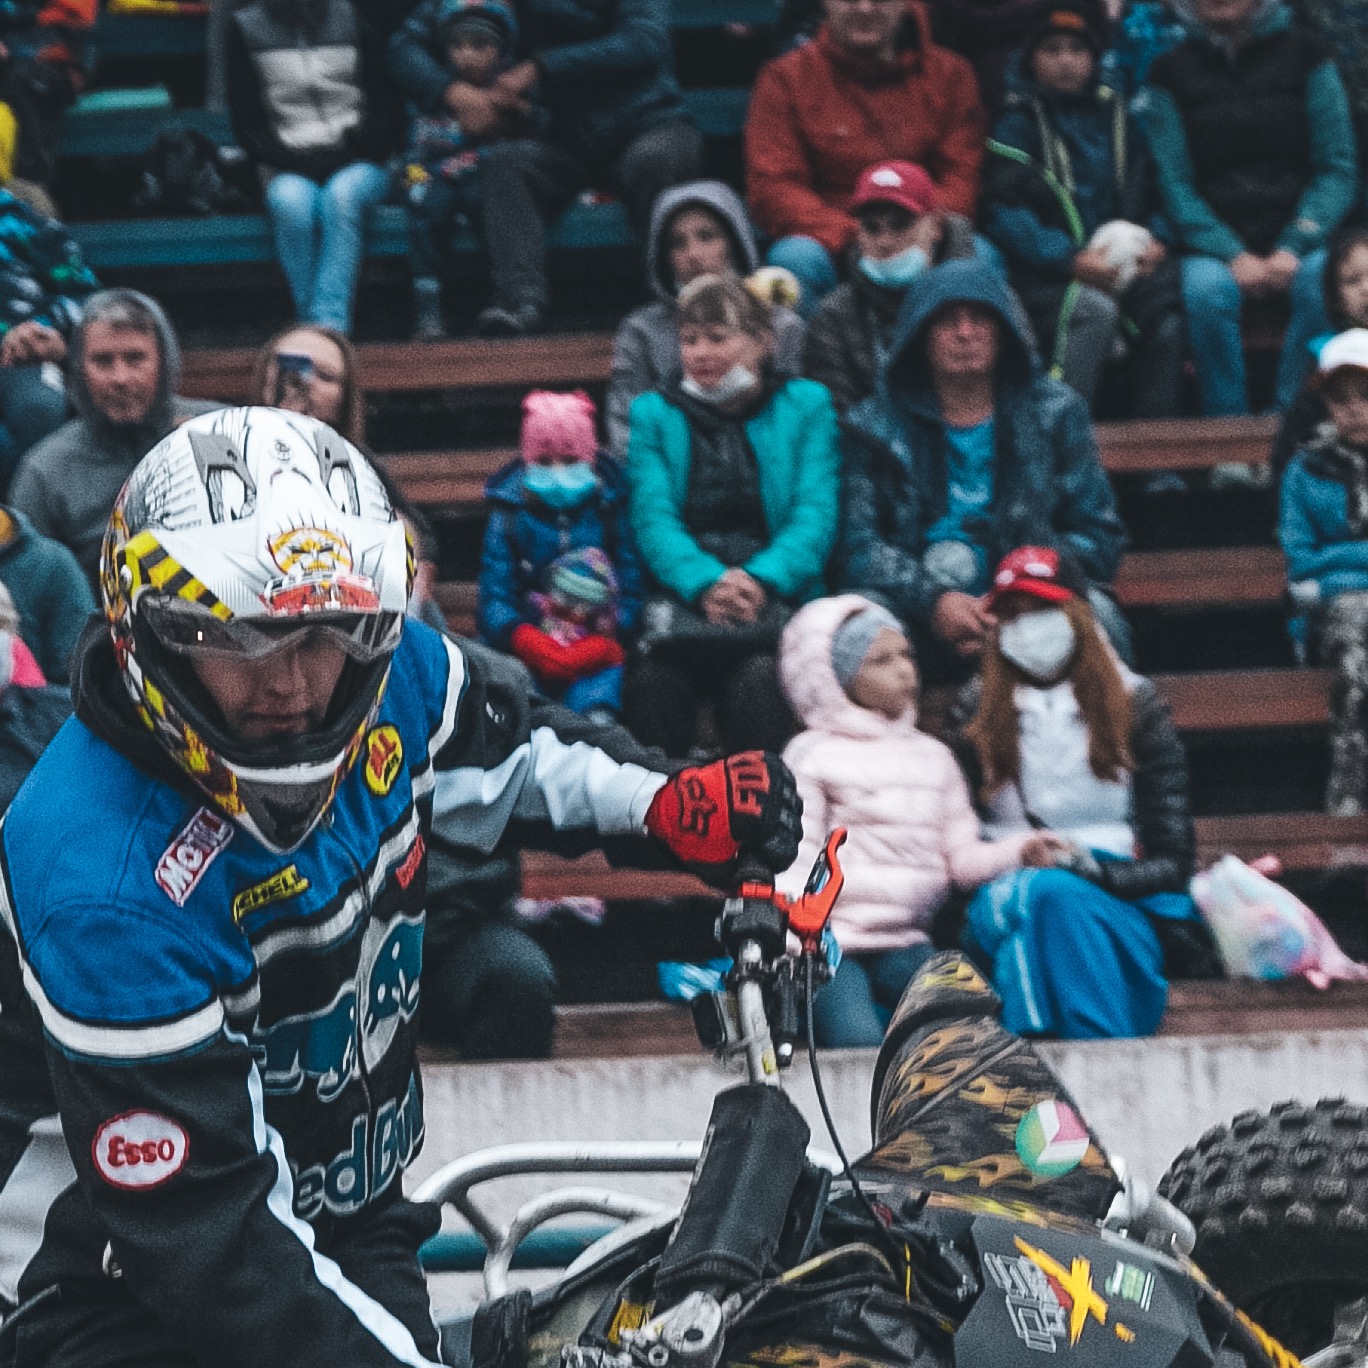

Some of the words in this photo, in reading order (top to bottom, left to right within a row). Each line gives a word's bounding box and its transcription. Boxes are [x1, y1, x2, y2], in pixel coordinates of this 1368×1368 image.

[107, 1135, 175, 1168] Esso
[292, 1112, 369, 1218] ed
[369, 1068, 426, 1203] Bul
